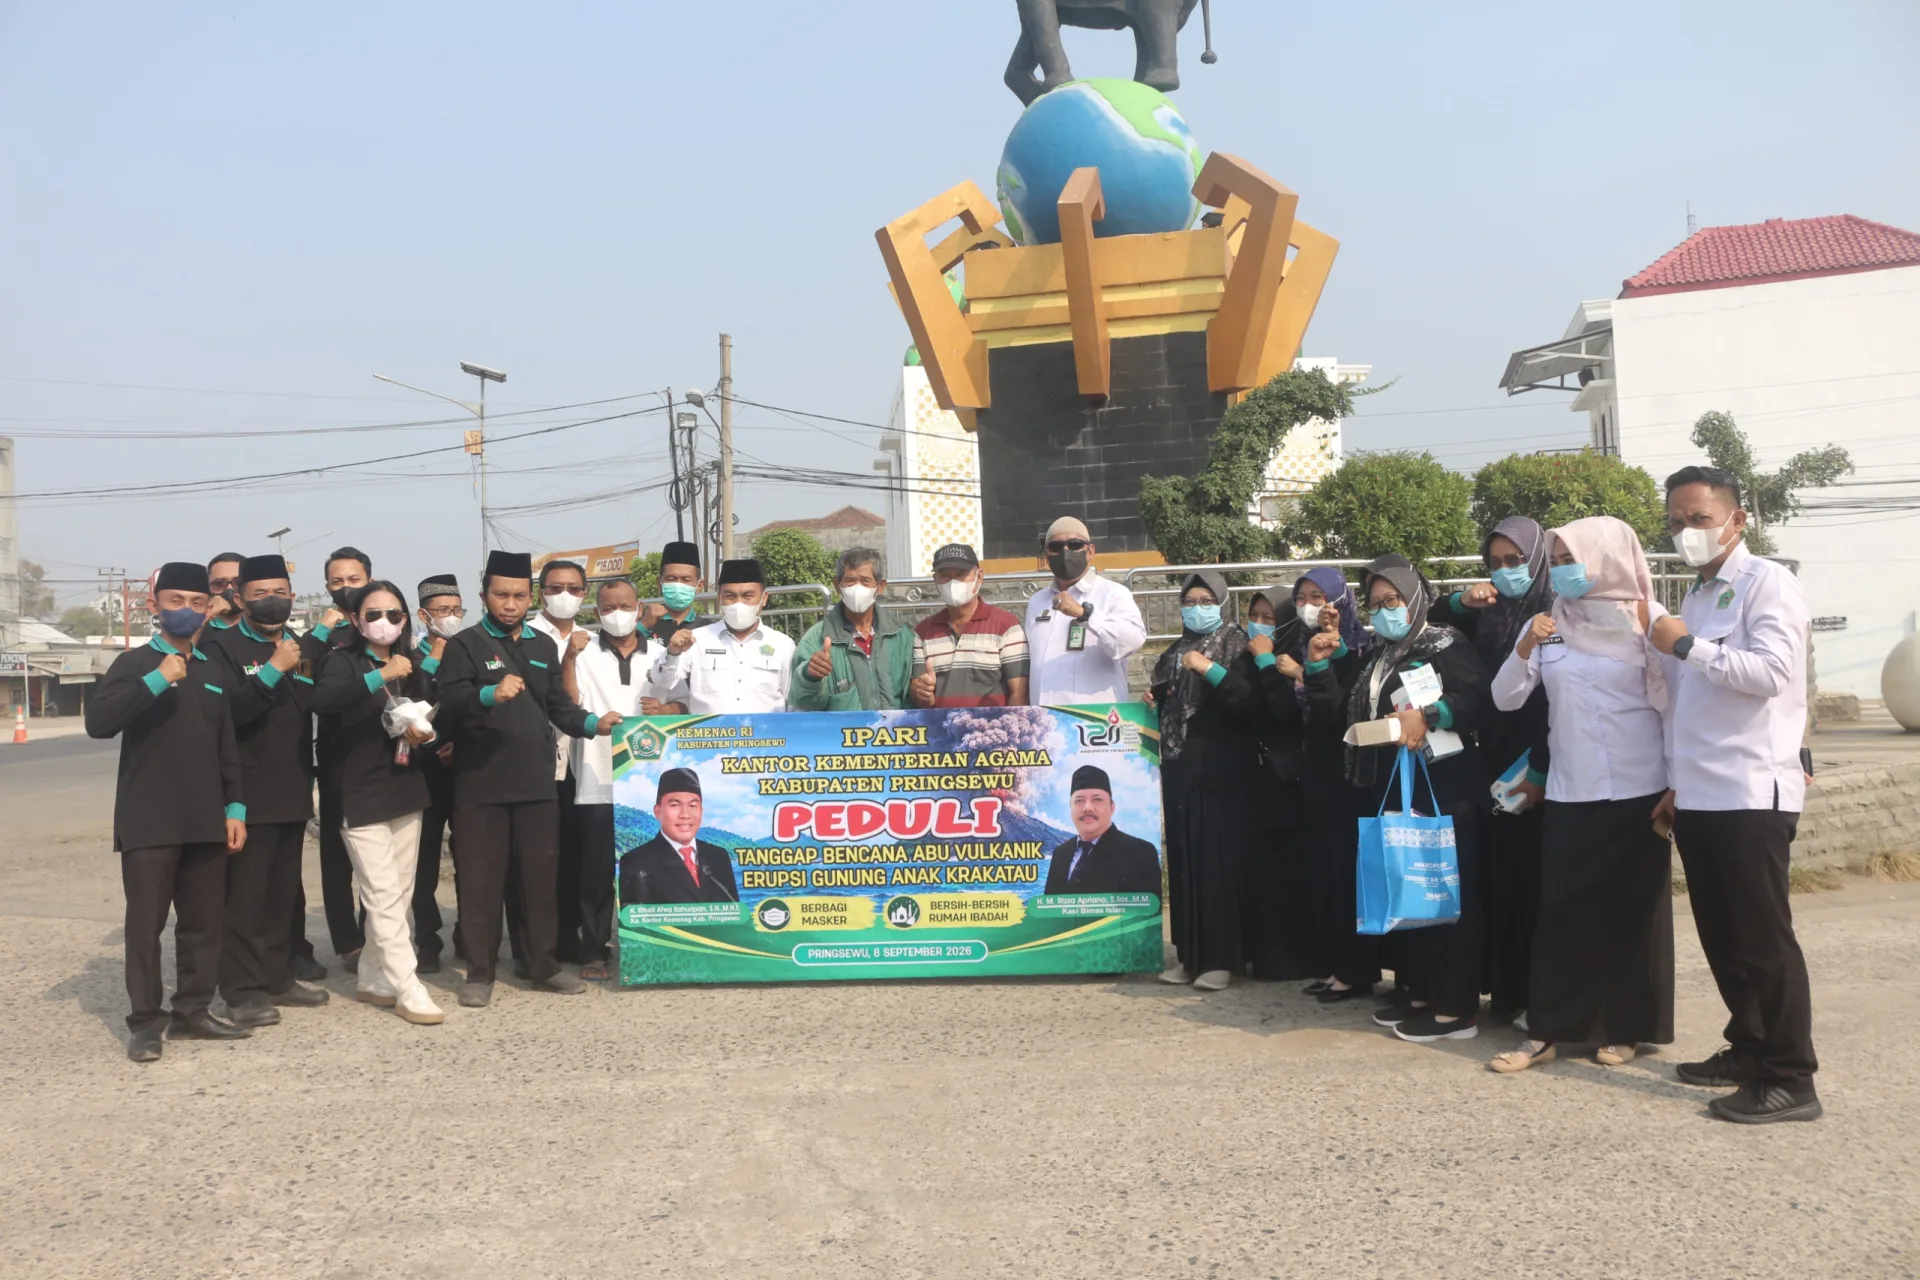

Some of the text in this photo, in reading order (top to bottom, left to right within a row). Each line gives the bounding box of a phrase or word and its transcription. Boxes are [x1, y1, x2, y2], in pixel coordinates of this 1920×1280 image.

[676, 727, 753, 738] KEMENAG RI
[842, 726, 928, 747] IPARI
[676, 738, 786, 749] KABUPATEN PRINGSEWU
[721, 749, 1052, 774] KANTOR KEMENTERIAN AGAMA
[758, 774, 1015, 795] KABUPATEN PRINGSEWU
[774, 798, 1003, 842] PEDULI
[735, 841, 1044, 866] TANGGAP BENCANA ABU VULKANIK
[743, 864, 1038, 888] ERUPSI GUNUNG ANAK KRAKATAU
[930, 900, 1009, 910] BERSIH-BERSIH
[1077, 896, 1108, 905] Apriano,
[801, 903, 847, 913] BERBAGI
[663, 916, 692, 924] Kemenag
[802, 916, 847, 926] MASKER
[929, 912, 1008, 922] RUMAH IBADAH
[808, 946, 972, 959] PRINGSEWU, 8 SEPTEMBER 2026
